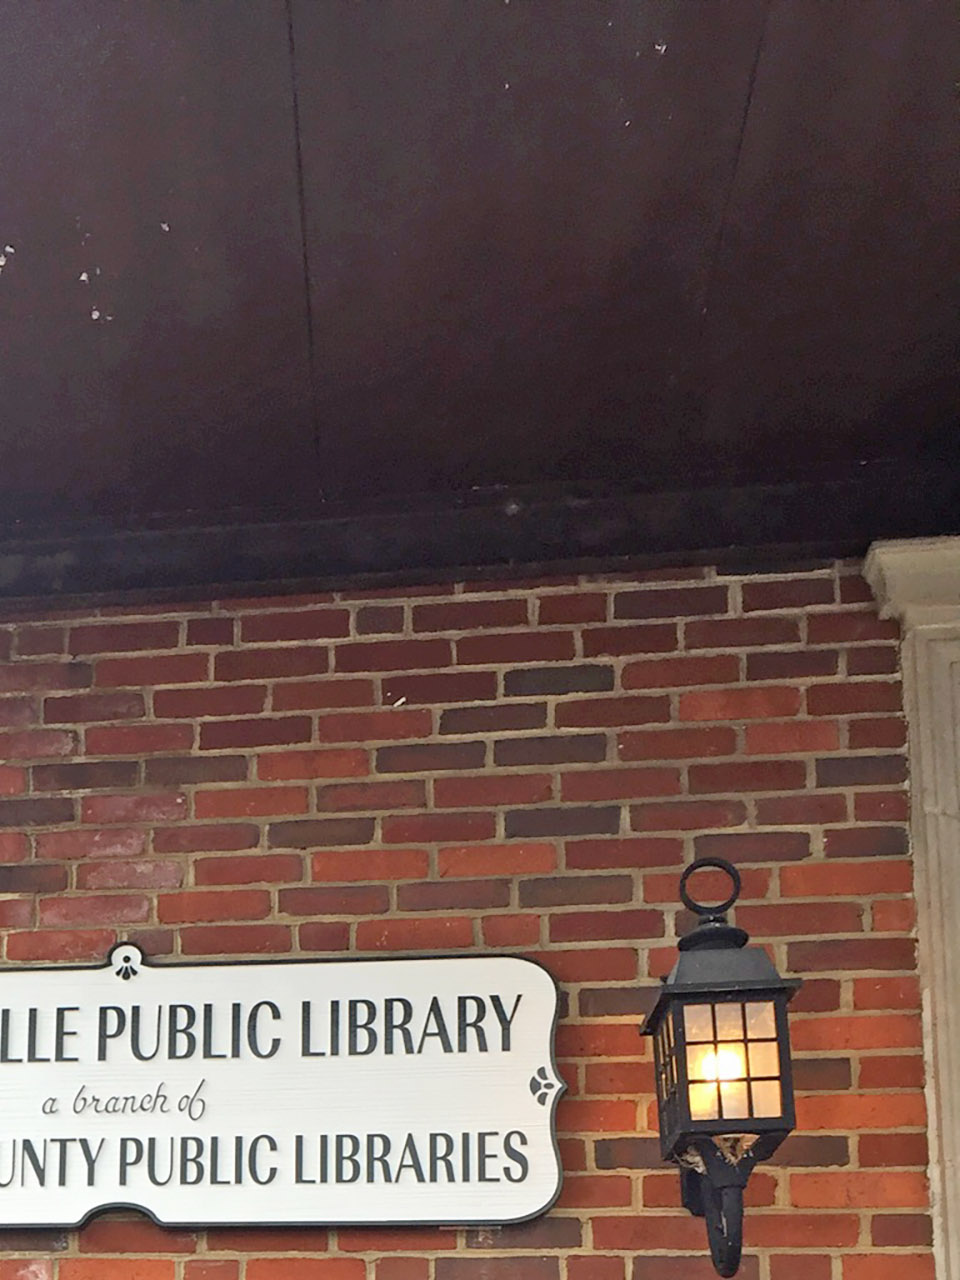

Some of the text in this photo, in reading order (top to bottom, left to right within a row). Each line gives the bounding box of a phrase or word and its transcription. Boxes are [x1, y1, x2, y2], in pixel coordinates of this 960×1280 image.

[97, 1000, 282, 1062] PUBLIC
[301, 993, 523, 1057] LIBRARY
[41, 1078, 207, 1122] a branch of
[119, 1134, 278, 1187] PUBLIC
[295, 1130, 529, 1184] LIBRARIES
